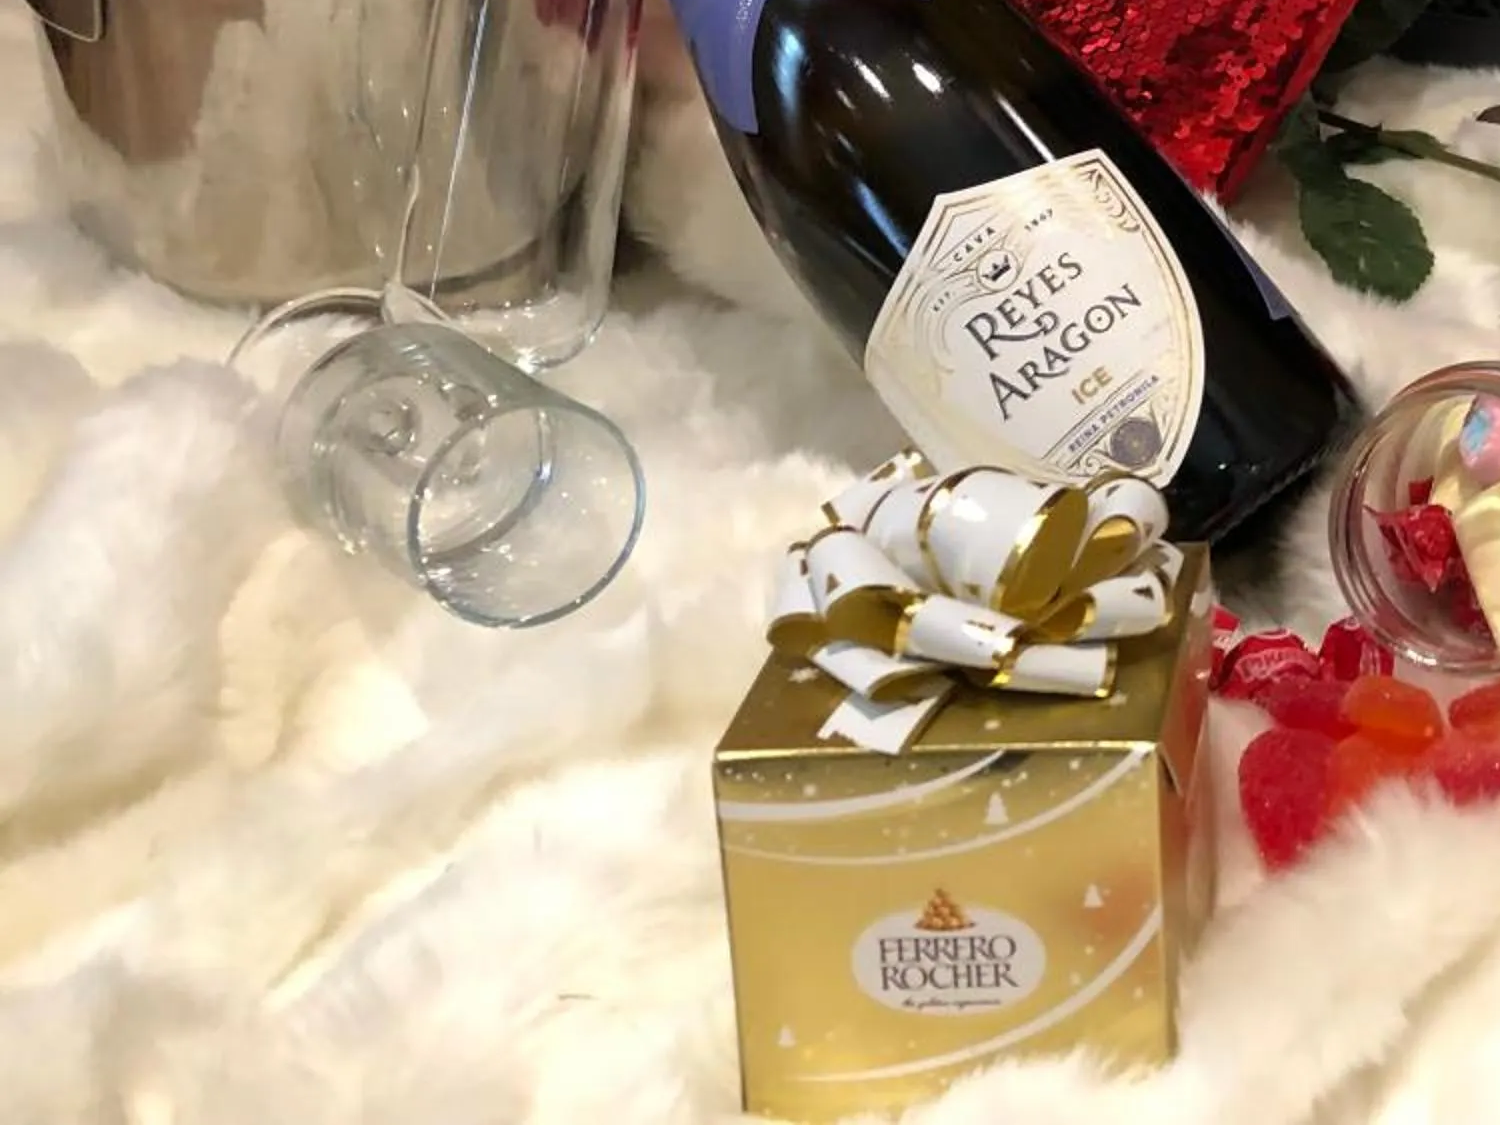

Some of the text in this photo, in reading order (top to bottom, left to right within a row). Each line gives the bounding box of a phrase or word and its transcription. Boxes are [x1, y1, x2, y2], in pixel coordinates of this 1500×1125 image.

[953, 226, 996, 262] CAVA
[965, 252, 1084, 361] REYES
[989, 284, 1143, 421] ARAGON
[1071, 366, 1113, 405] ICE
[1068, 421, 1099, 452] REINA
[878, 934, 1018, 964] FERRERO
[881, 962, 1019, 992] ROCHER
